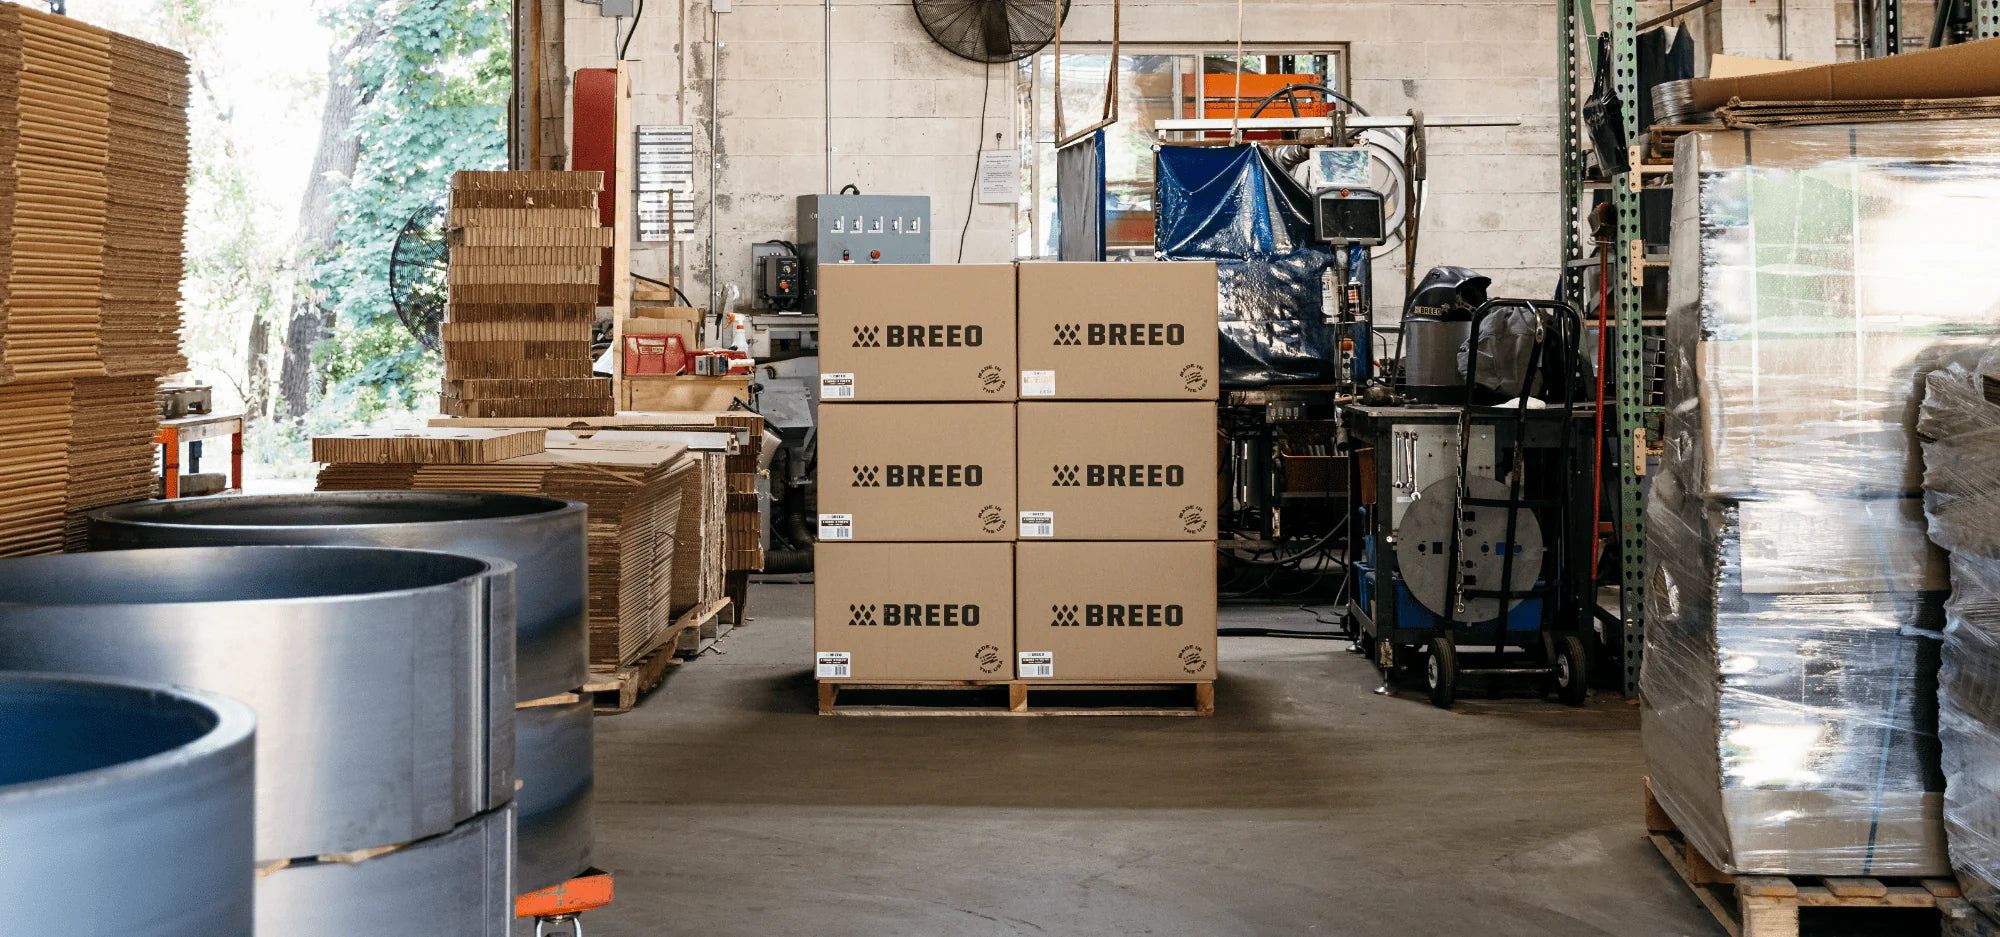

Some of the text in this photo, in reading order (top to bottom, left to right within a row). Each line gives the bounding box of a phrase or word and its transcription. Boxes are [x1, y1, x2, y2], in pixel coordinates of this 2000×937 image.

[887, 325, 982, 347] BREEO
[1088, 324, 1185, 346] BREEO
[978, 365, 993, 378] MADE
[1180, 364, 1195, 377] MADE
[996, 381, 1006, 391] USA
[1198, 379, 1208, 391] USA
[887, 465, 982, 487] BREEO
[1087, 465, 1183, 486] BREEO
[978, 505, 993, 518] MADE
[1179, 505, 1194, 518] MADE
[996, 520, 1006, 532] USA
[1197, 520, 1207, 532] USA
[884, 604, 980, 627] BREEO
[1086, 604, 1183, 627] BREEO
[975, 645, 990, 658] MADE
[1178, 645, 1193, 658] MADE
[993, 660, 1003, 672] USA
[1184, 660, 1207, 674] THE USA
